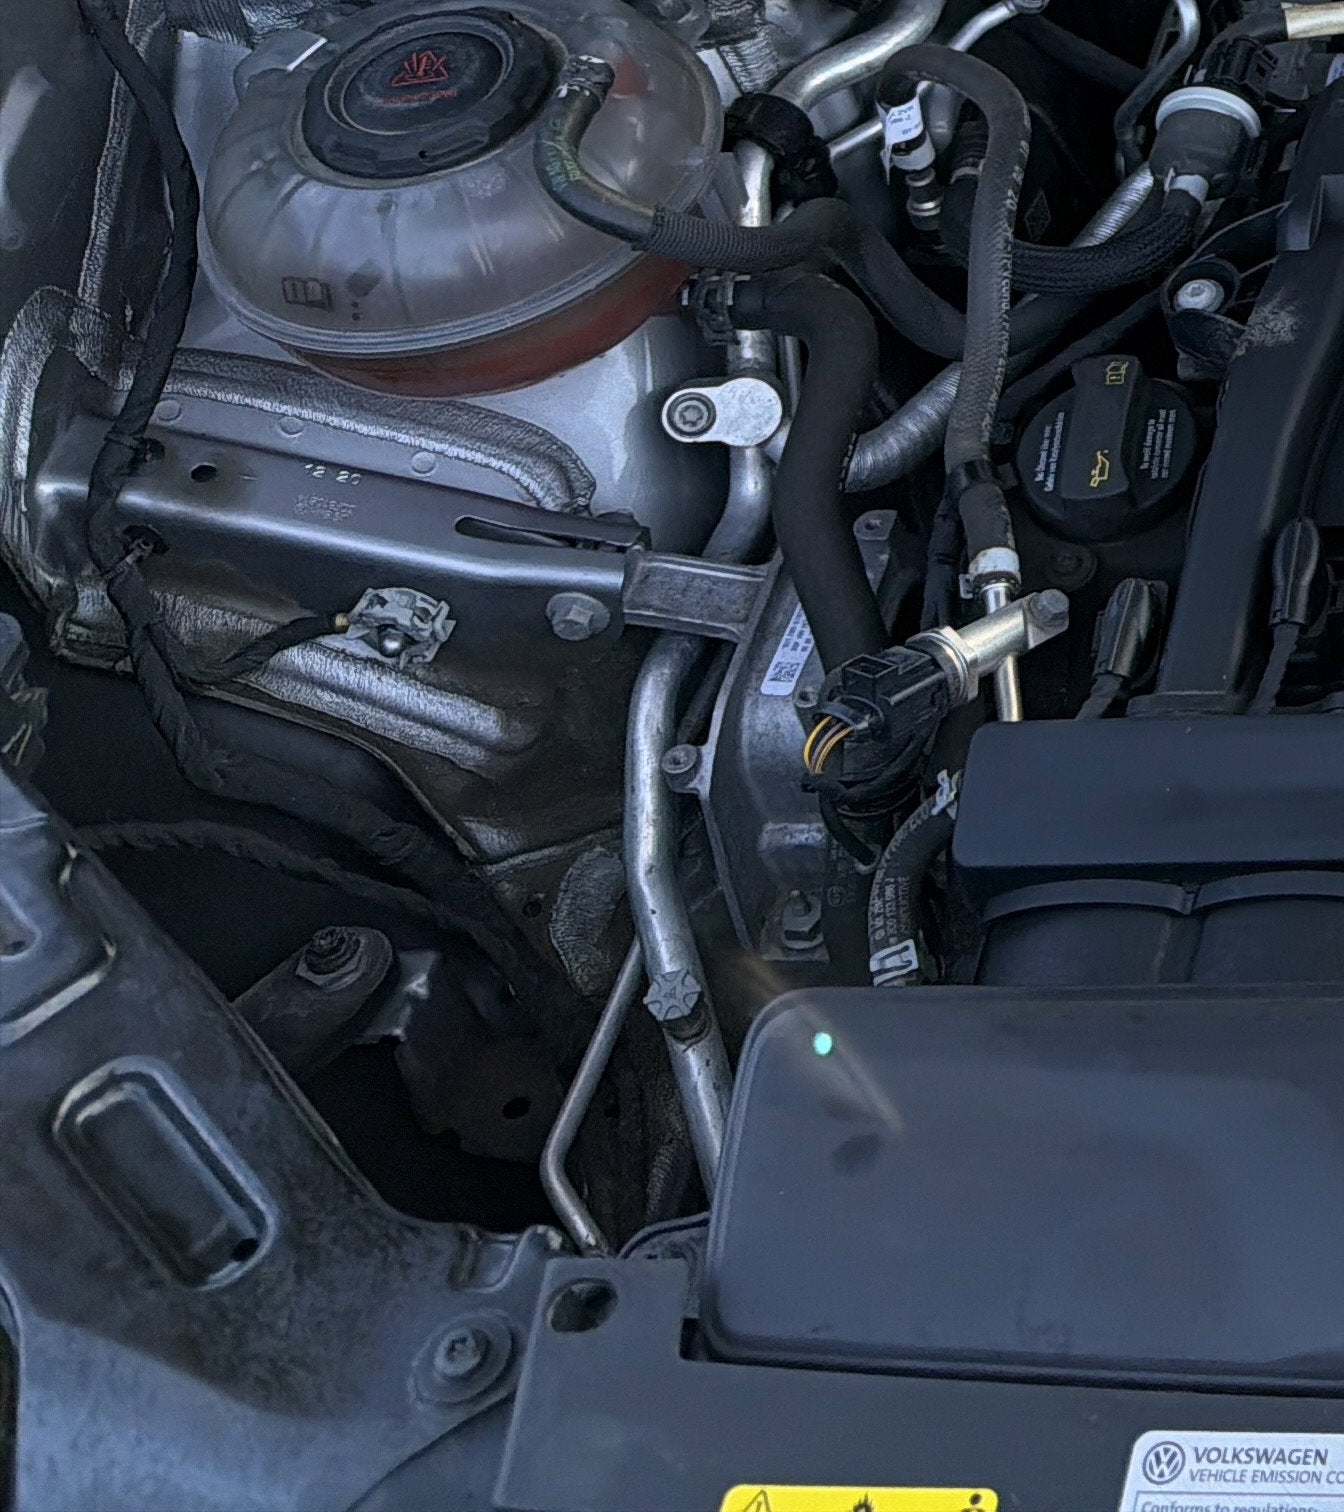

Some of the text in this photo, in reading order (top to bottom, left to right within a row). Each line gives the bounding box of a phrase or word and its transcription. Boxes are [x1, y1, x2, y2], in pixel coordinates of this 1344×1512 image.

[1193, 1446, 1329, 1467] VOLKSWAGEN
[1189, 1468, 1248, 1485] VEHICLE
[1251, 1469, 1324, 1486] EMISSION
